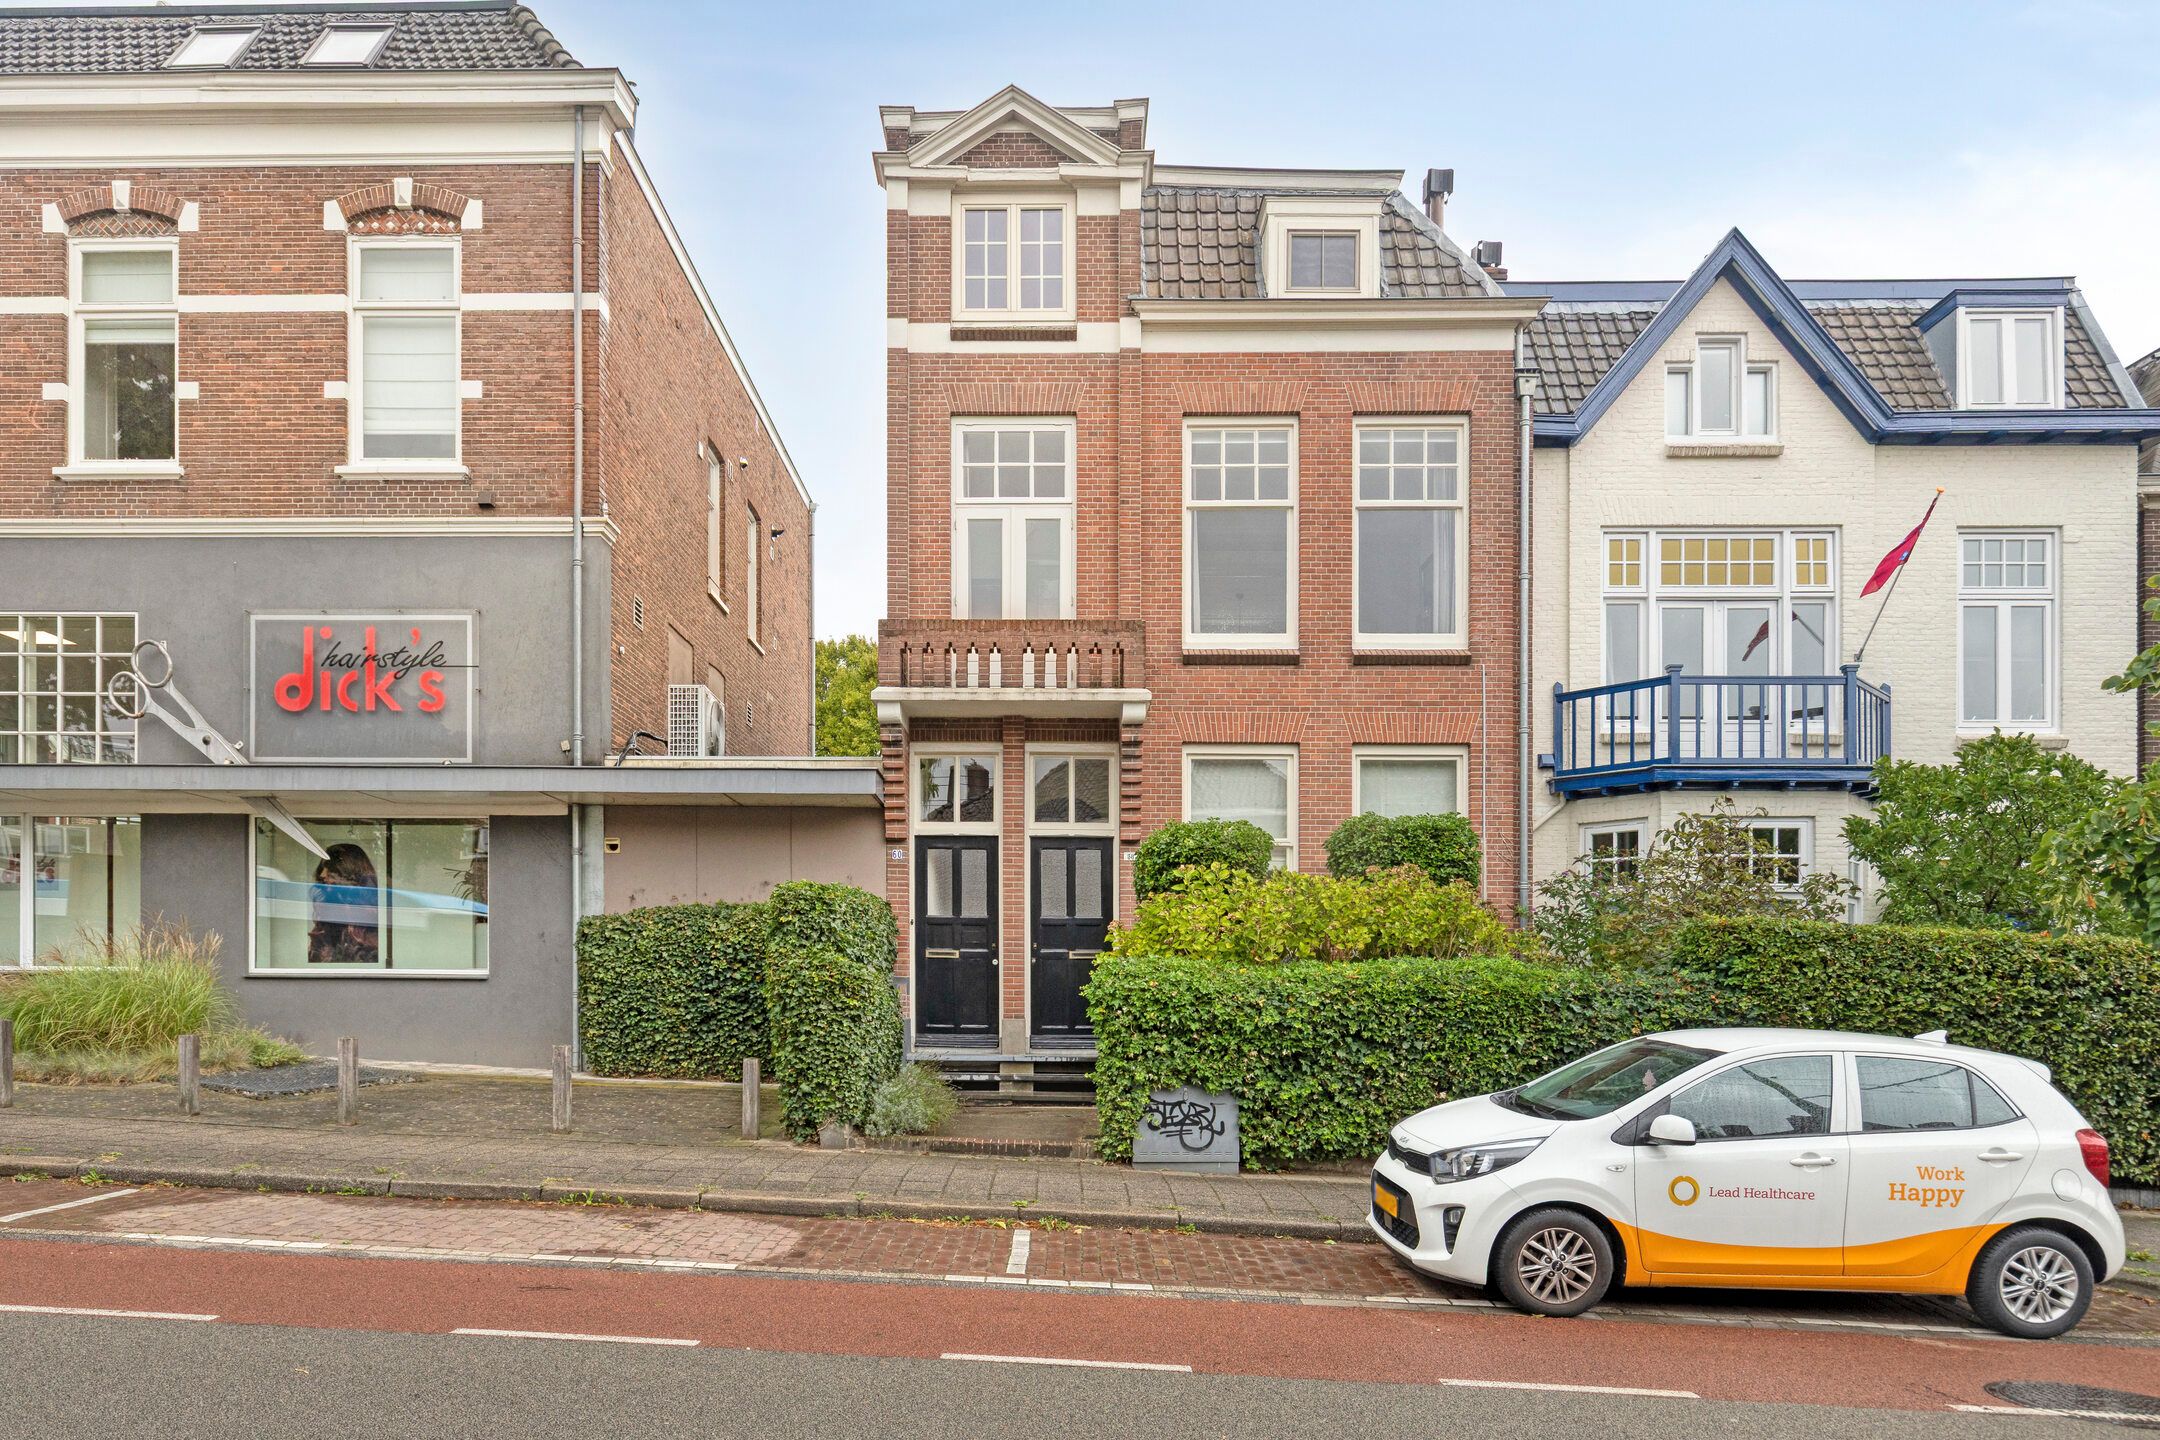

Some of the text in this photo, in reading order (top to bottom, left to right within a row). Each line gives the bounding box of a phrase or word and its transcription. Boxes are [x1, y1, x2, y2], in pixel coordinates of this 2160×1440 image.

[274, 625, 446, 712] dick's
[320, 640, 448, 680] hairstyle
[892, 849, 903, 859] 60
[1916, 1166, 1965, 1181] Work
[1709, 1186, 1815, 1200] Lead Healthcare
[1888, 1183, 1965, 1207] Happy
